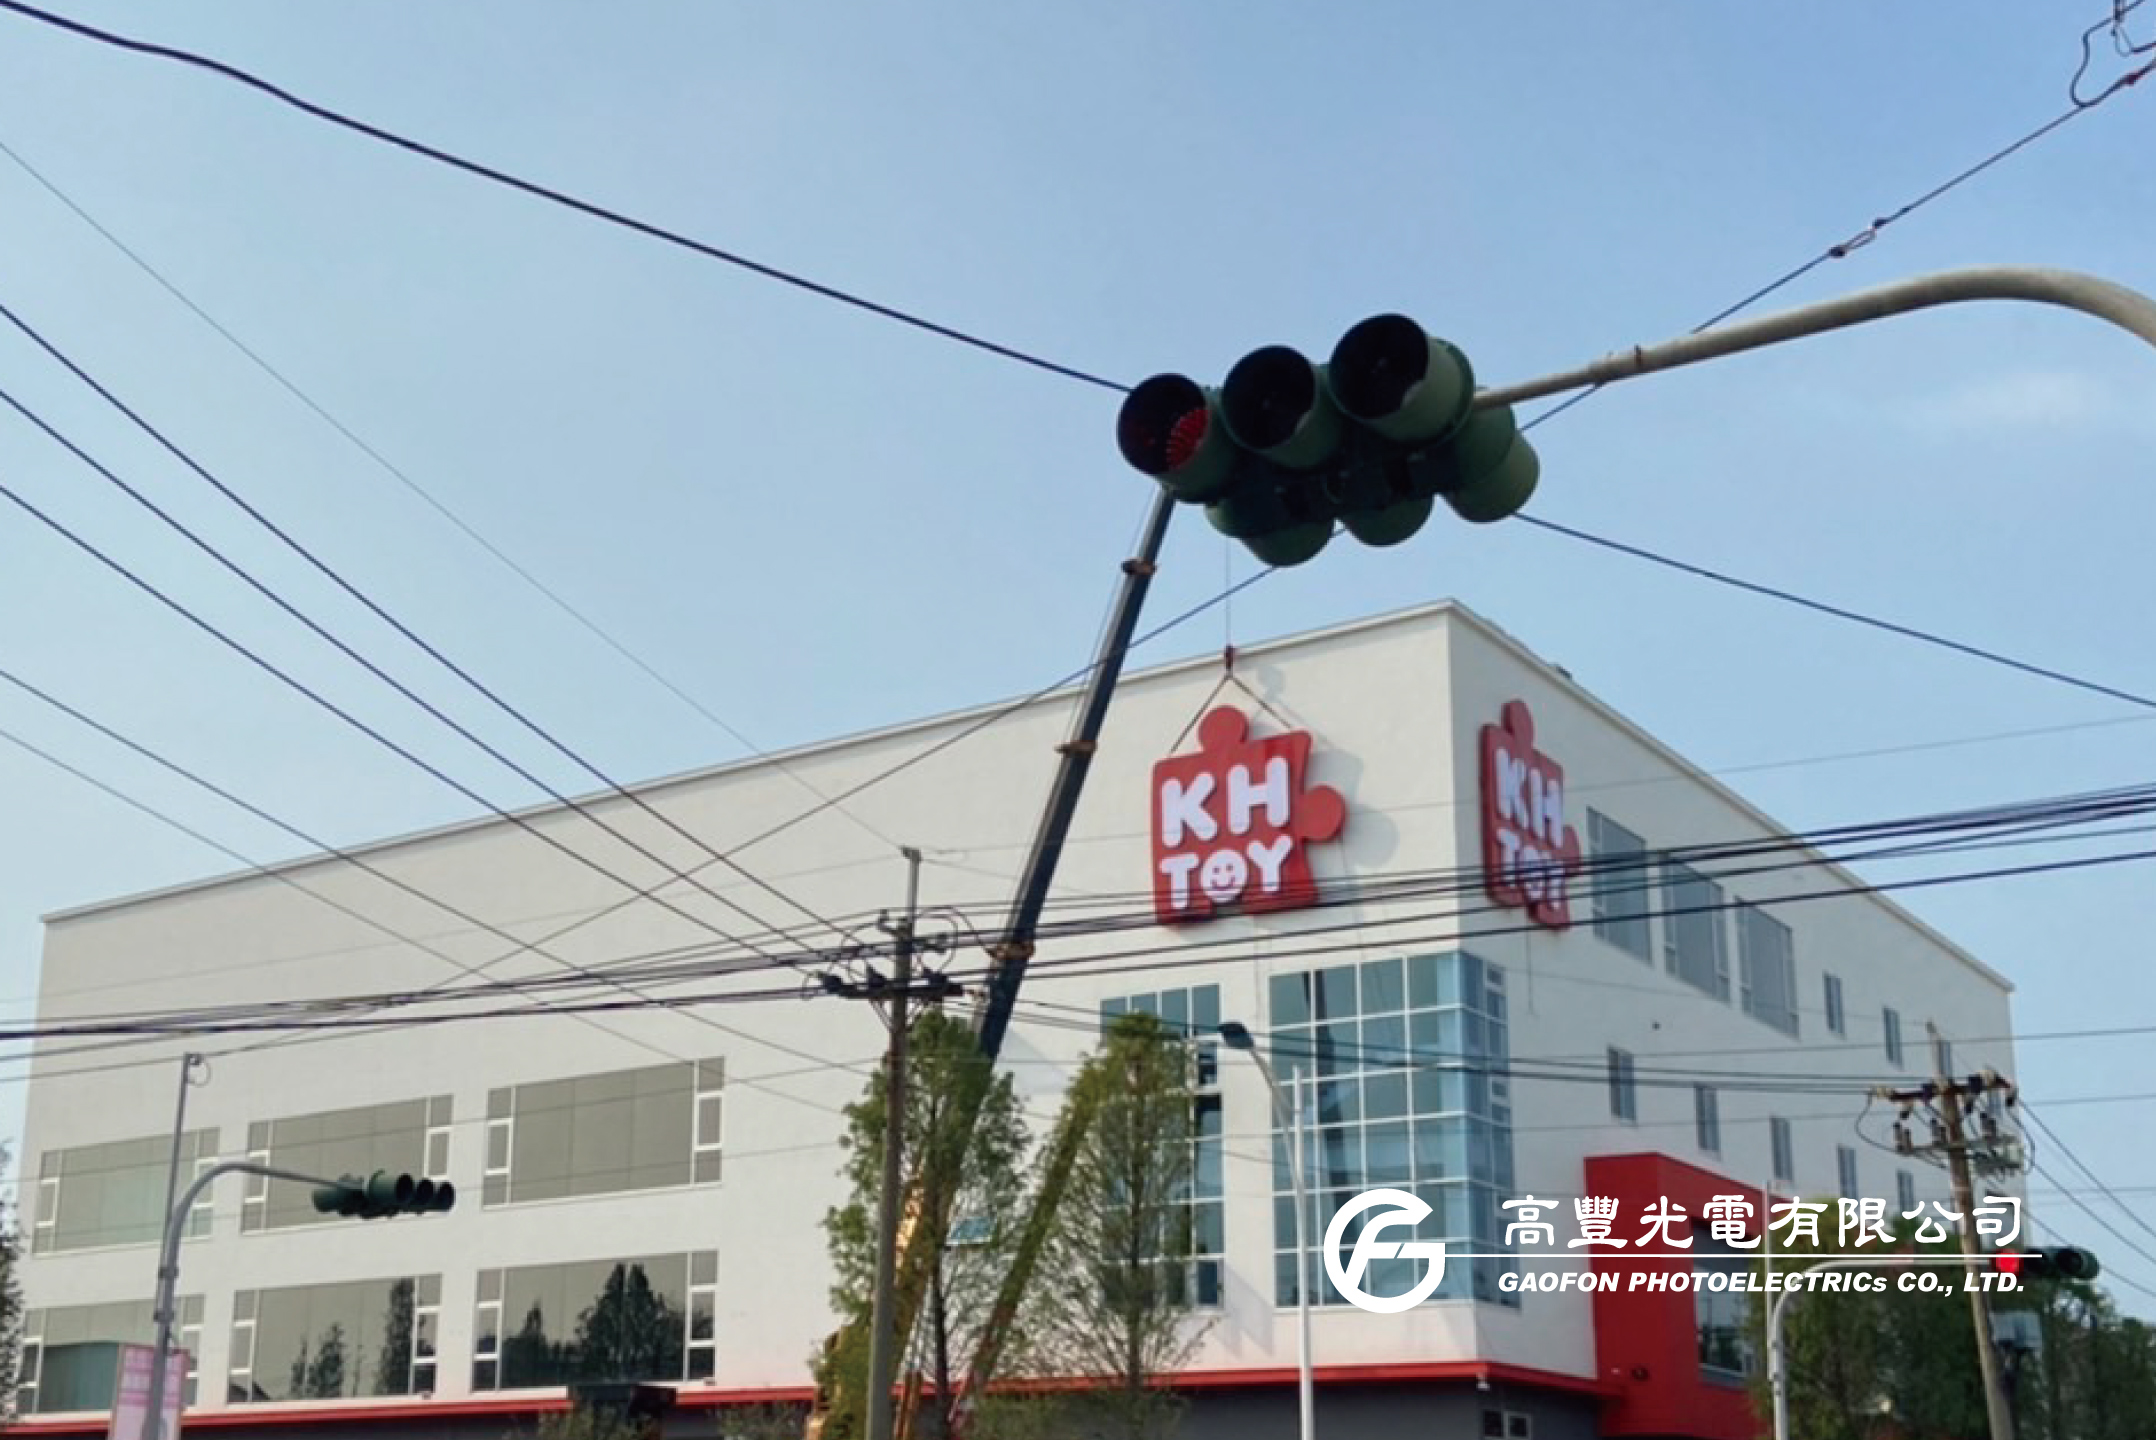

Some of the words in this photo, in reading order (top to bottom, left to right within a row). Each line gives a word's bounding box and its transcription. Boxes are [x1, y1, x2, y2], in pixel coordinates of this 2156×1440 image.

[1161, 755, 1290, 847] KH
[1496, 748, 1563, 849] KH
[1159, 834, 1294, 909] TOY
[1497, 828, 1563, 910] TOY
